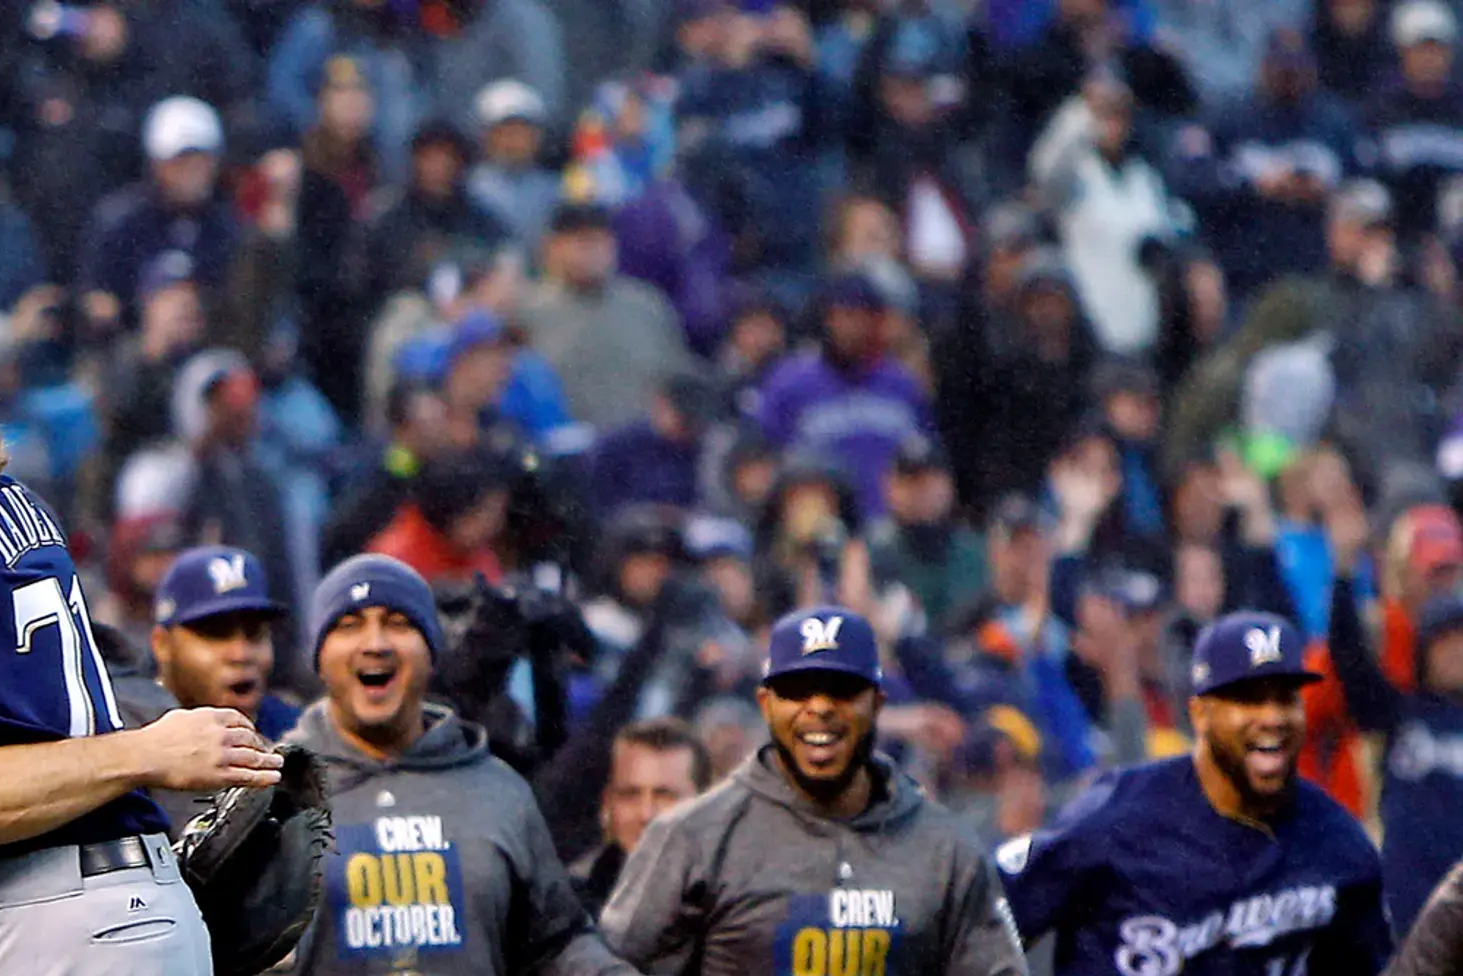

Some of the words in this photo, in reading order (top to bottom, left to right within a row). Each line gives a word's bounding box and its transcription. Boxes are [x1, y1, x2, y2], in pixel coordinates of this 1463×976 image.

[11, 572, 124, 740] 71
[376, 815, 451, 852] CREW.
[346, 851, 450, 910] OUR
[345, 903, 462, 949] OCTOBER.
[829, 888, 901, 928] CREW.
